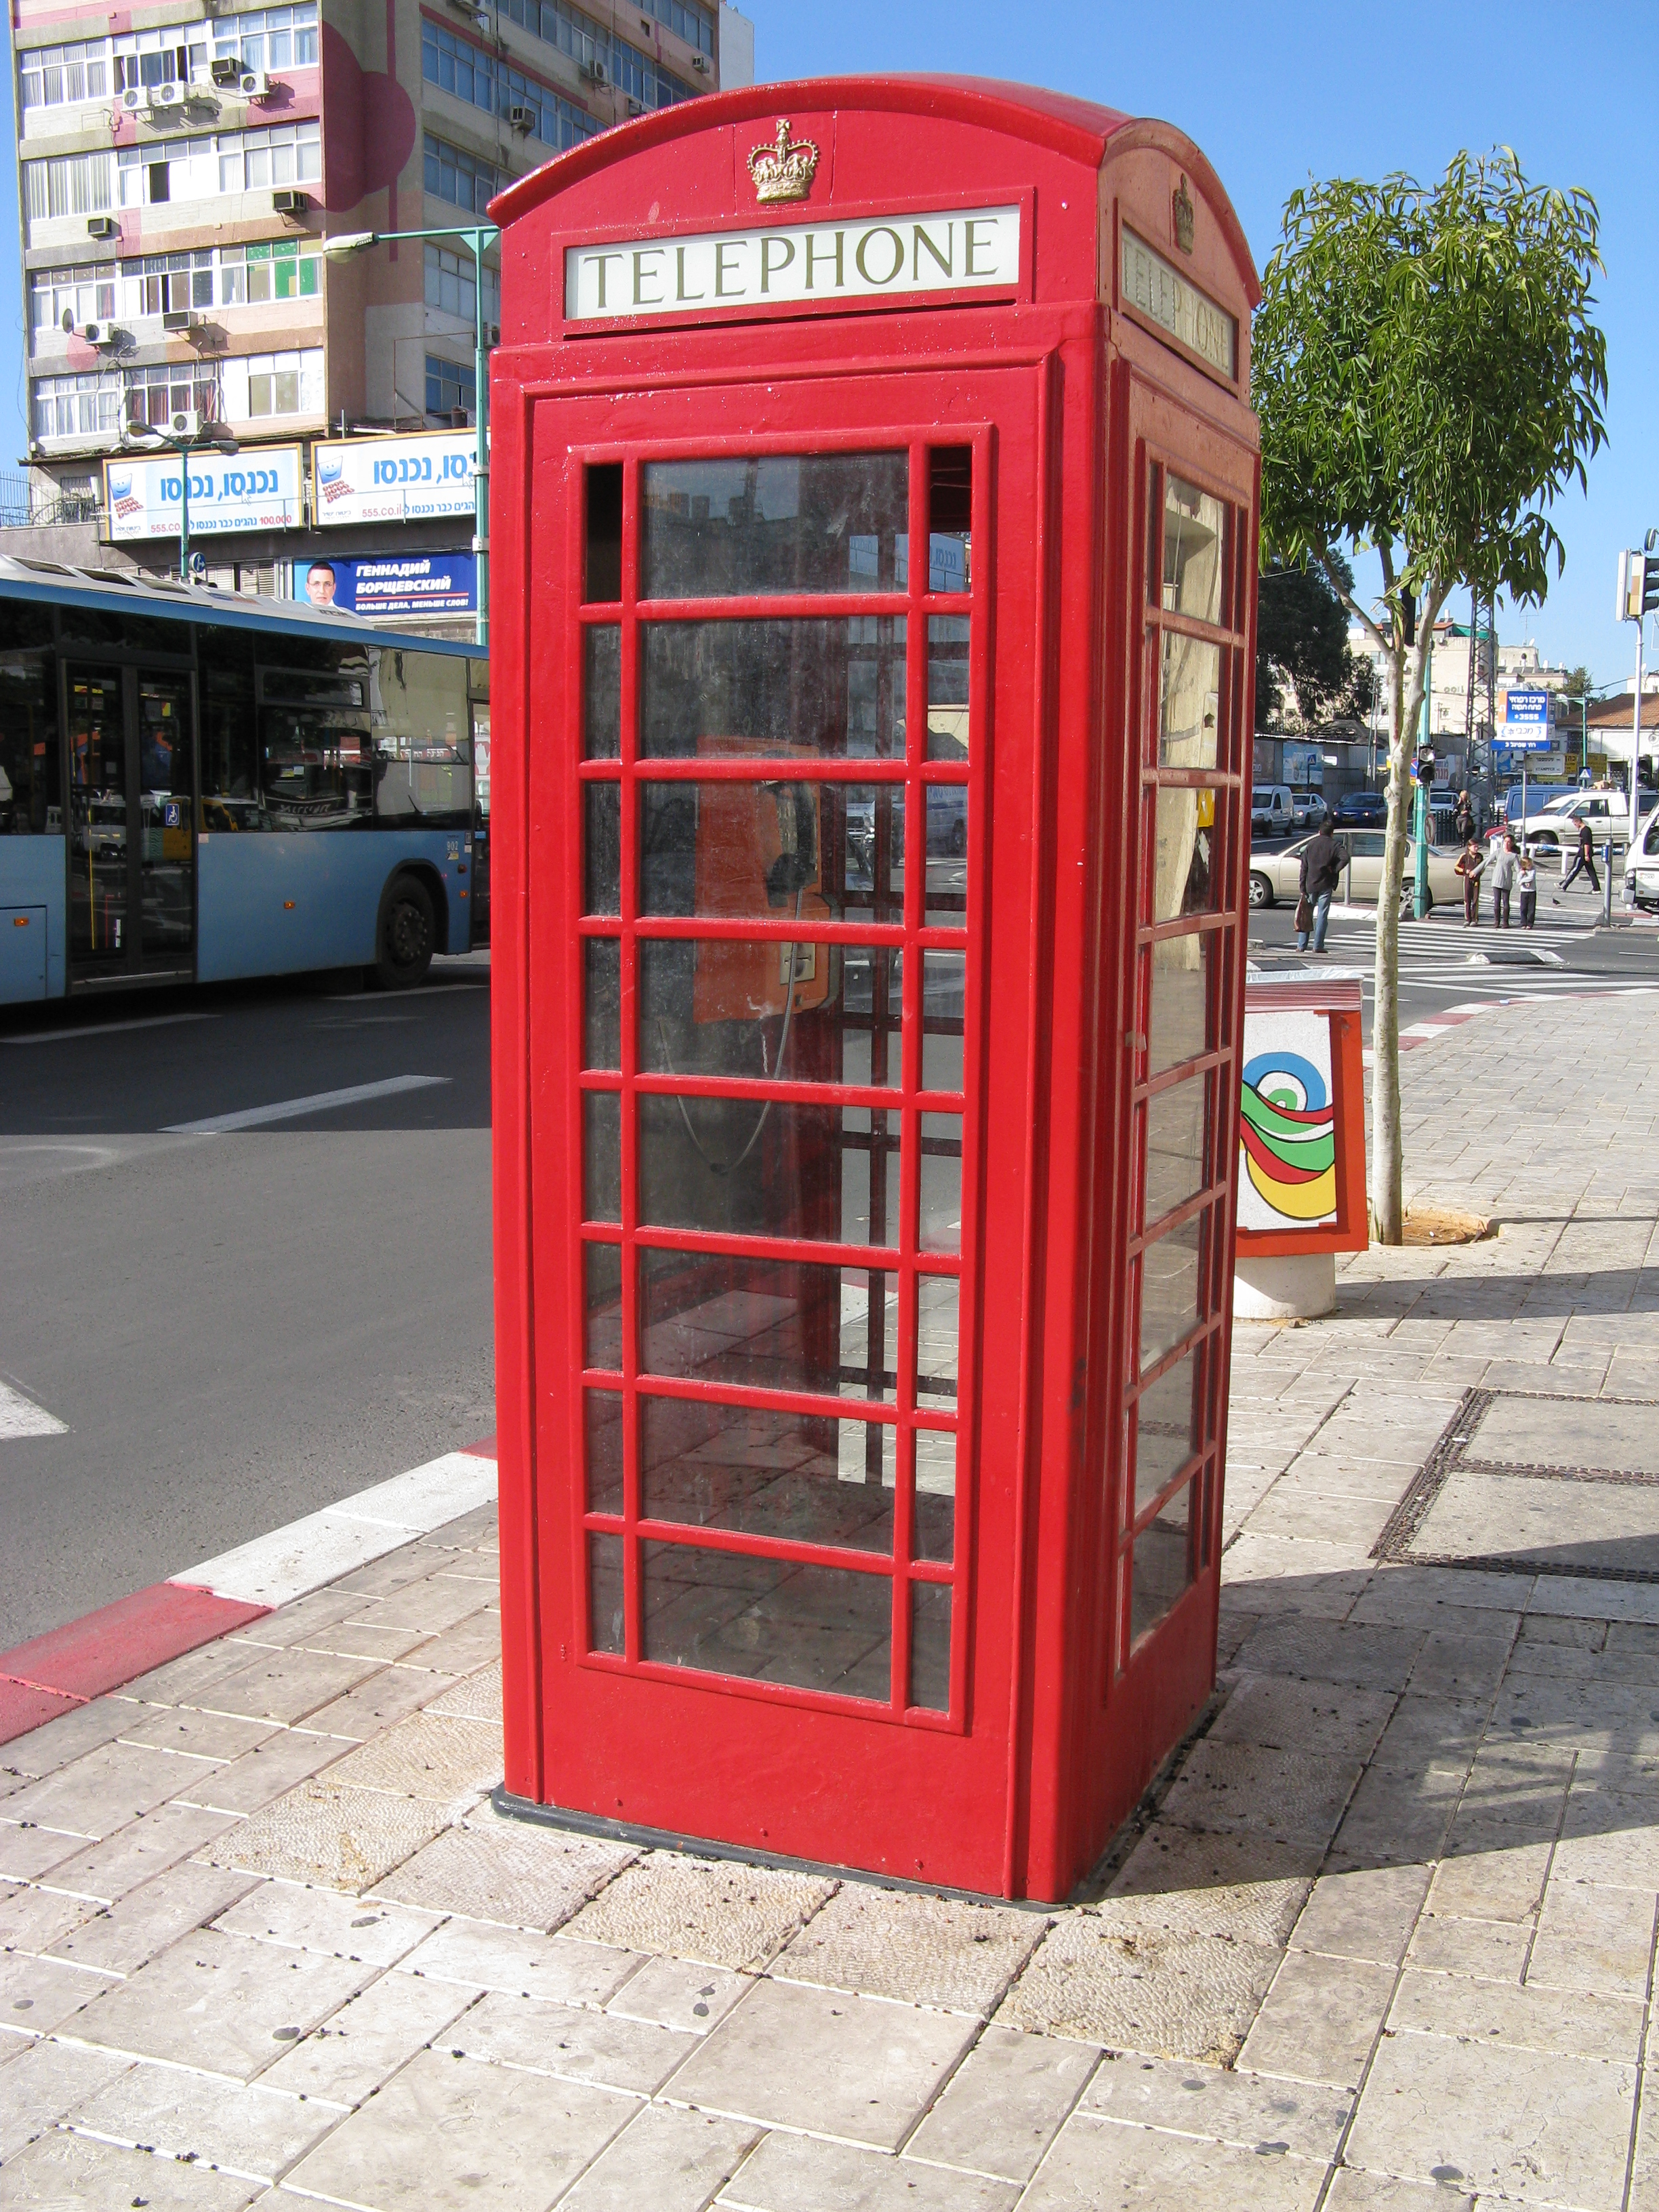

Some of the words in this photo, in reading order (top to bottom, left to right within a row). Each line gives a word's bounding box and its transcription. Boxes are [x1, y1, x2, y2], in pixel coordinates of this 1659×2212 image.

[583, 218, 1000, 308] TELEPHONE
[1122, 235, 1229, 370] TELEPHONE
[374, 457, 432, 485] נכנסו
[218, 469, 279, 502] נכנסו,
[412, 504, 434, 514] נכנסו
[436, 503, 452, 512] כבר
[453, 501, 475, 511] הגים
[196, 520, 217, 529] נכנסו
[218, 519, 232, 528] כבר
[234, 516, 258, 527] נהגים
[260, 514, 292, 526] 100,000
[356, 559, 431, 577] ГЕННАДИЙ
[356, 575, 452, 594] БОРЩЕВСКИЙ
[355, 602, 387, 611] БОЛЬШЕ
[388, 601, 411, 611] ДЕЛА,
[412, 599, 445, 609] МЕНЬШЕ
[446, 598, 469, 607] СЛОВ!
